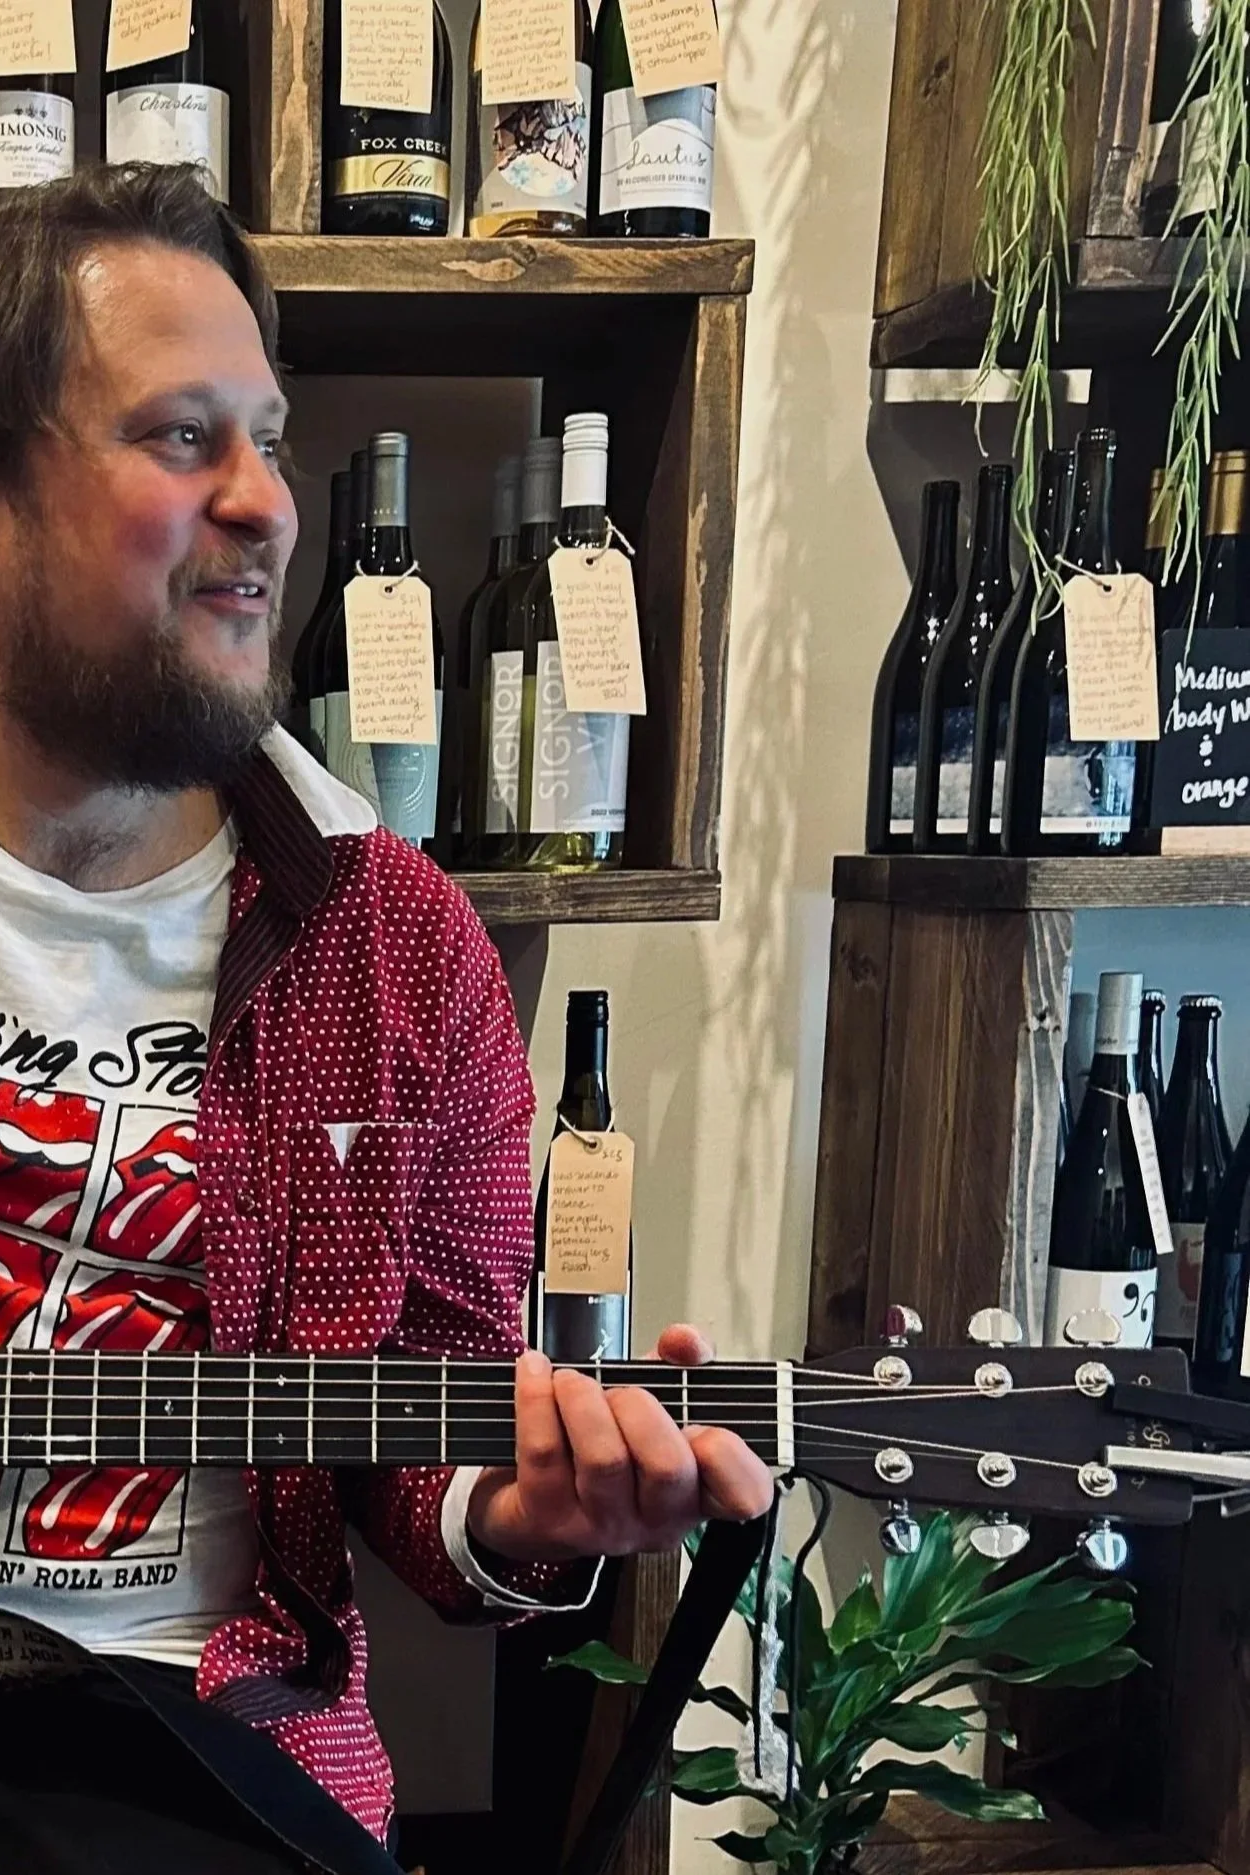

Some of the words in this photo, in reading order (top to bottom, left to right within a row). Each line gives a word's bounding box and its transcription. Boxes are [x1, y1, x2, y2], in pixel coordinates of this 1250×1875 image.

[360, 137, 397, 150] FOX
[372, 159, 432, 188] Vixen
[492, 664, 523, 802] SIGNOR
[1173, 700, 1227, 735] body
[1181, 775, 1250, 809] orange
[33, 1566, 103, 1590] ROLL
[112, 1562, 178, 1588] BAND
